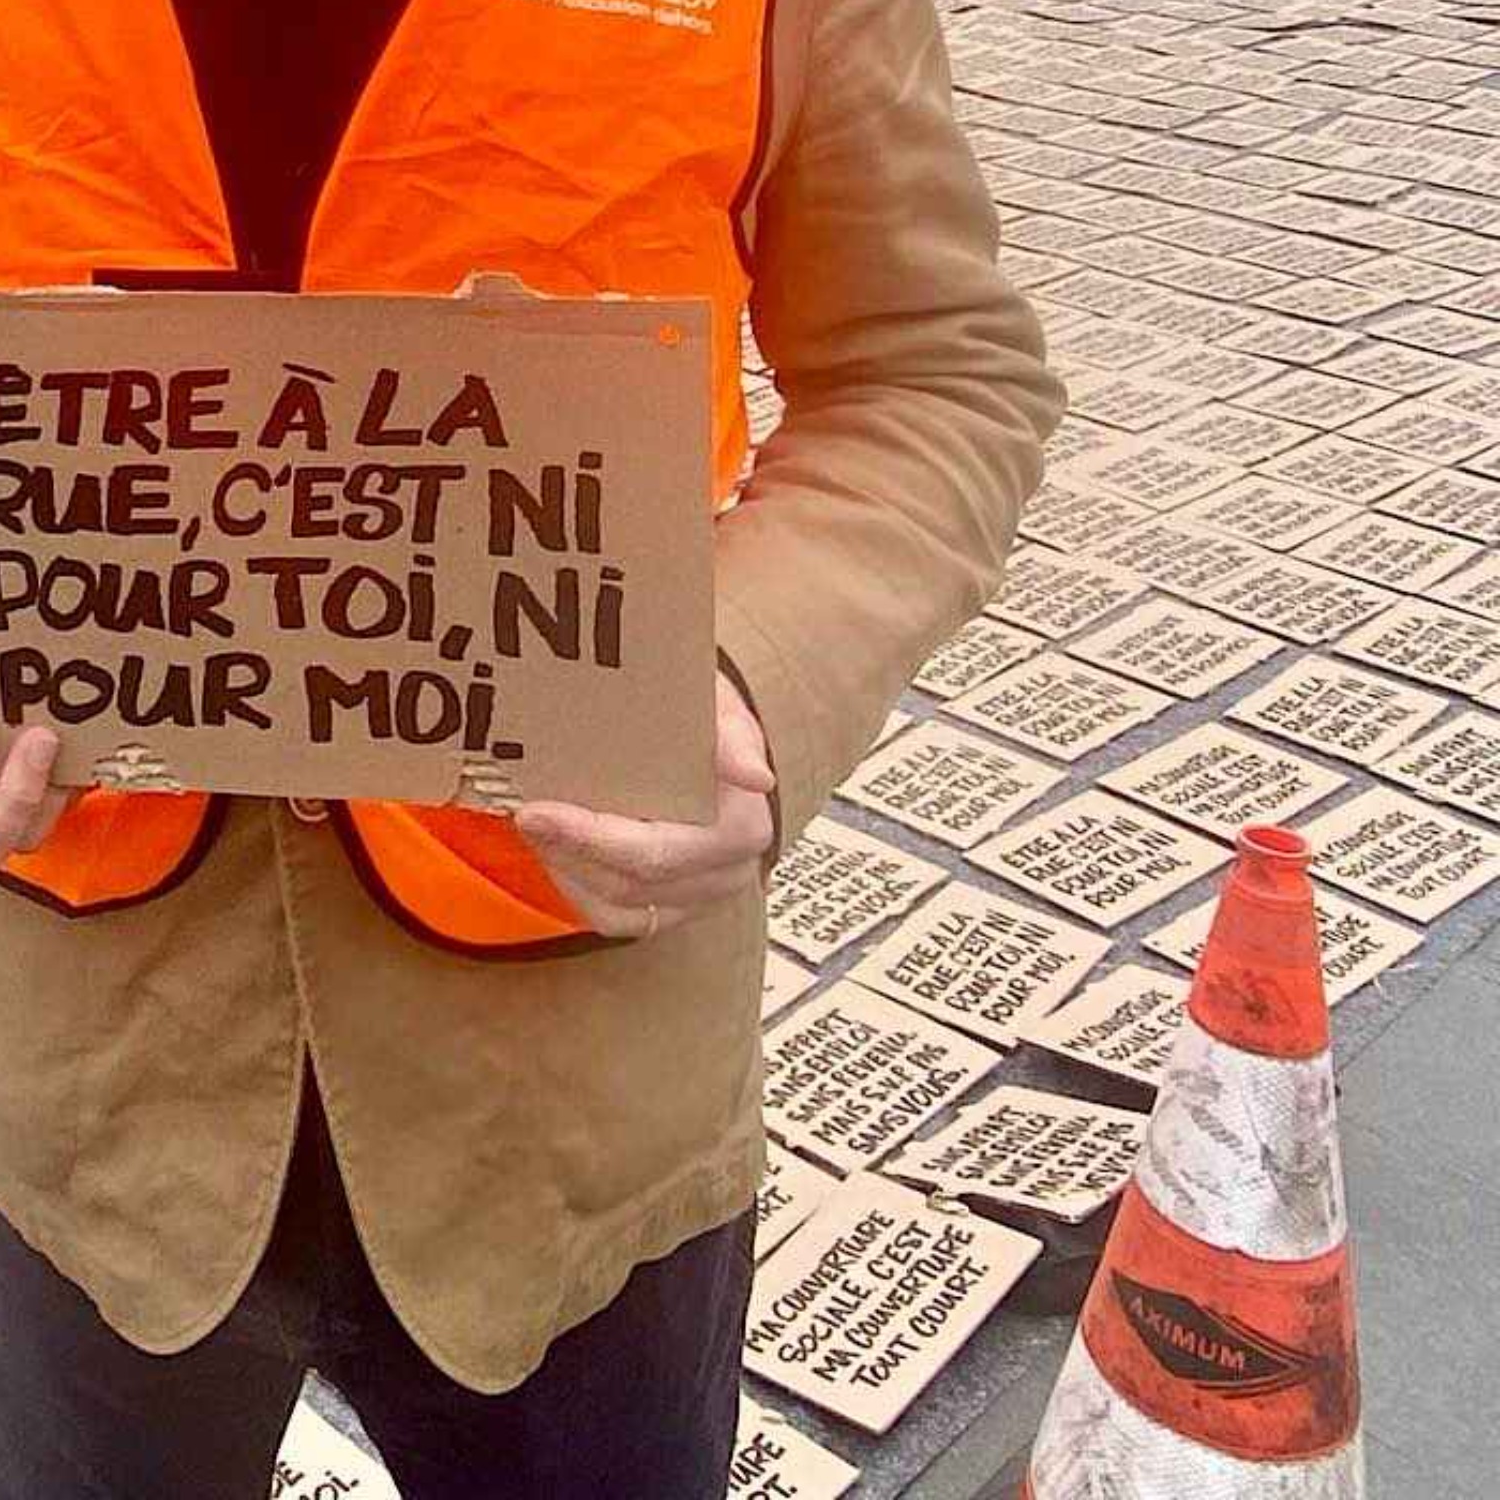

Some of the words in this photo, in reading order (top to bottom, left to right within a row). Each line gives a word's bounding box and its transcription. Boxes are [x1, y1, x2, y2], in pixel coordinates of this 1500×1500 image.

[258, 362, 335, 451] À
[355, 367, 508, 449] LA
[213, 461, 466, 543] C'EST
[741, 1320, 785, 1353] MA
[772, 1209, 895, 1330] COUVERTURE
[867, 1219, 931, 1280] C'EST
[811, 1348, 861, 1382] MA
[843, 1223, 974, 1349] COUVERTURE
[849, 1332, 920, 1387] TOUT
[908, 1256, 988, 1337] COURT.
[1129, 1296, 1244, 1369] AXIMUM
